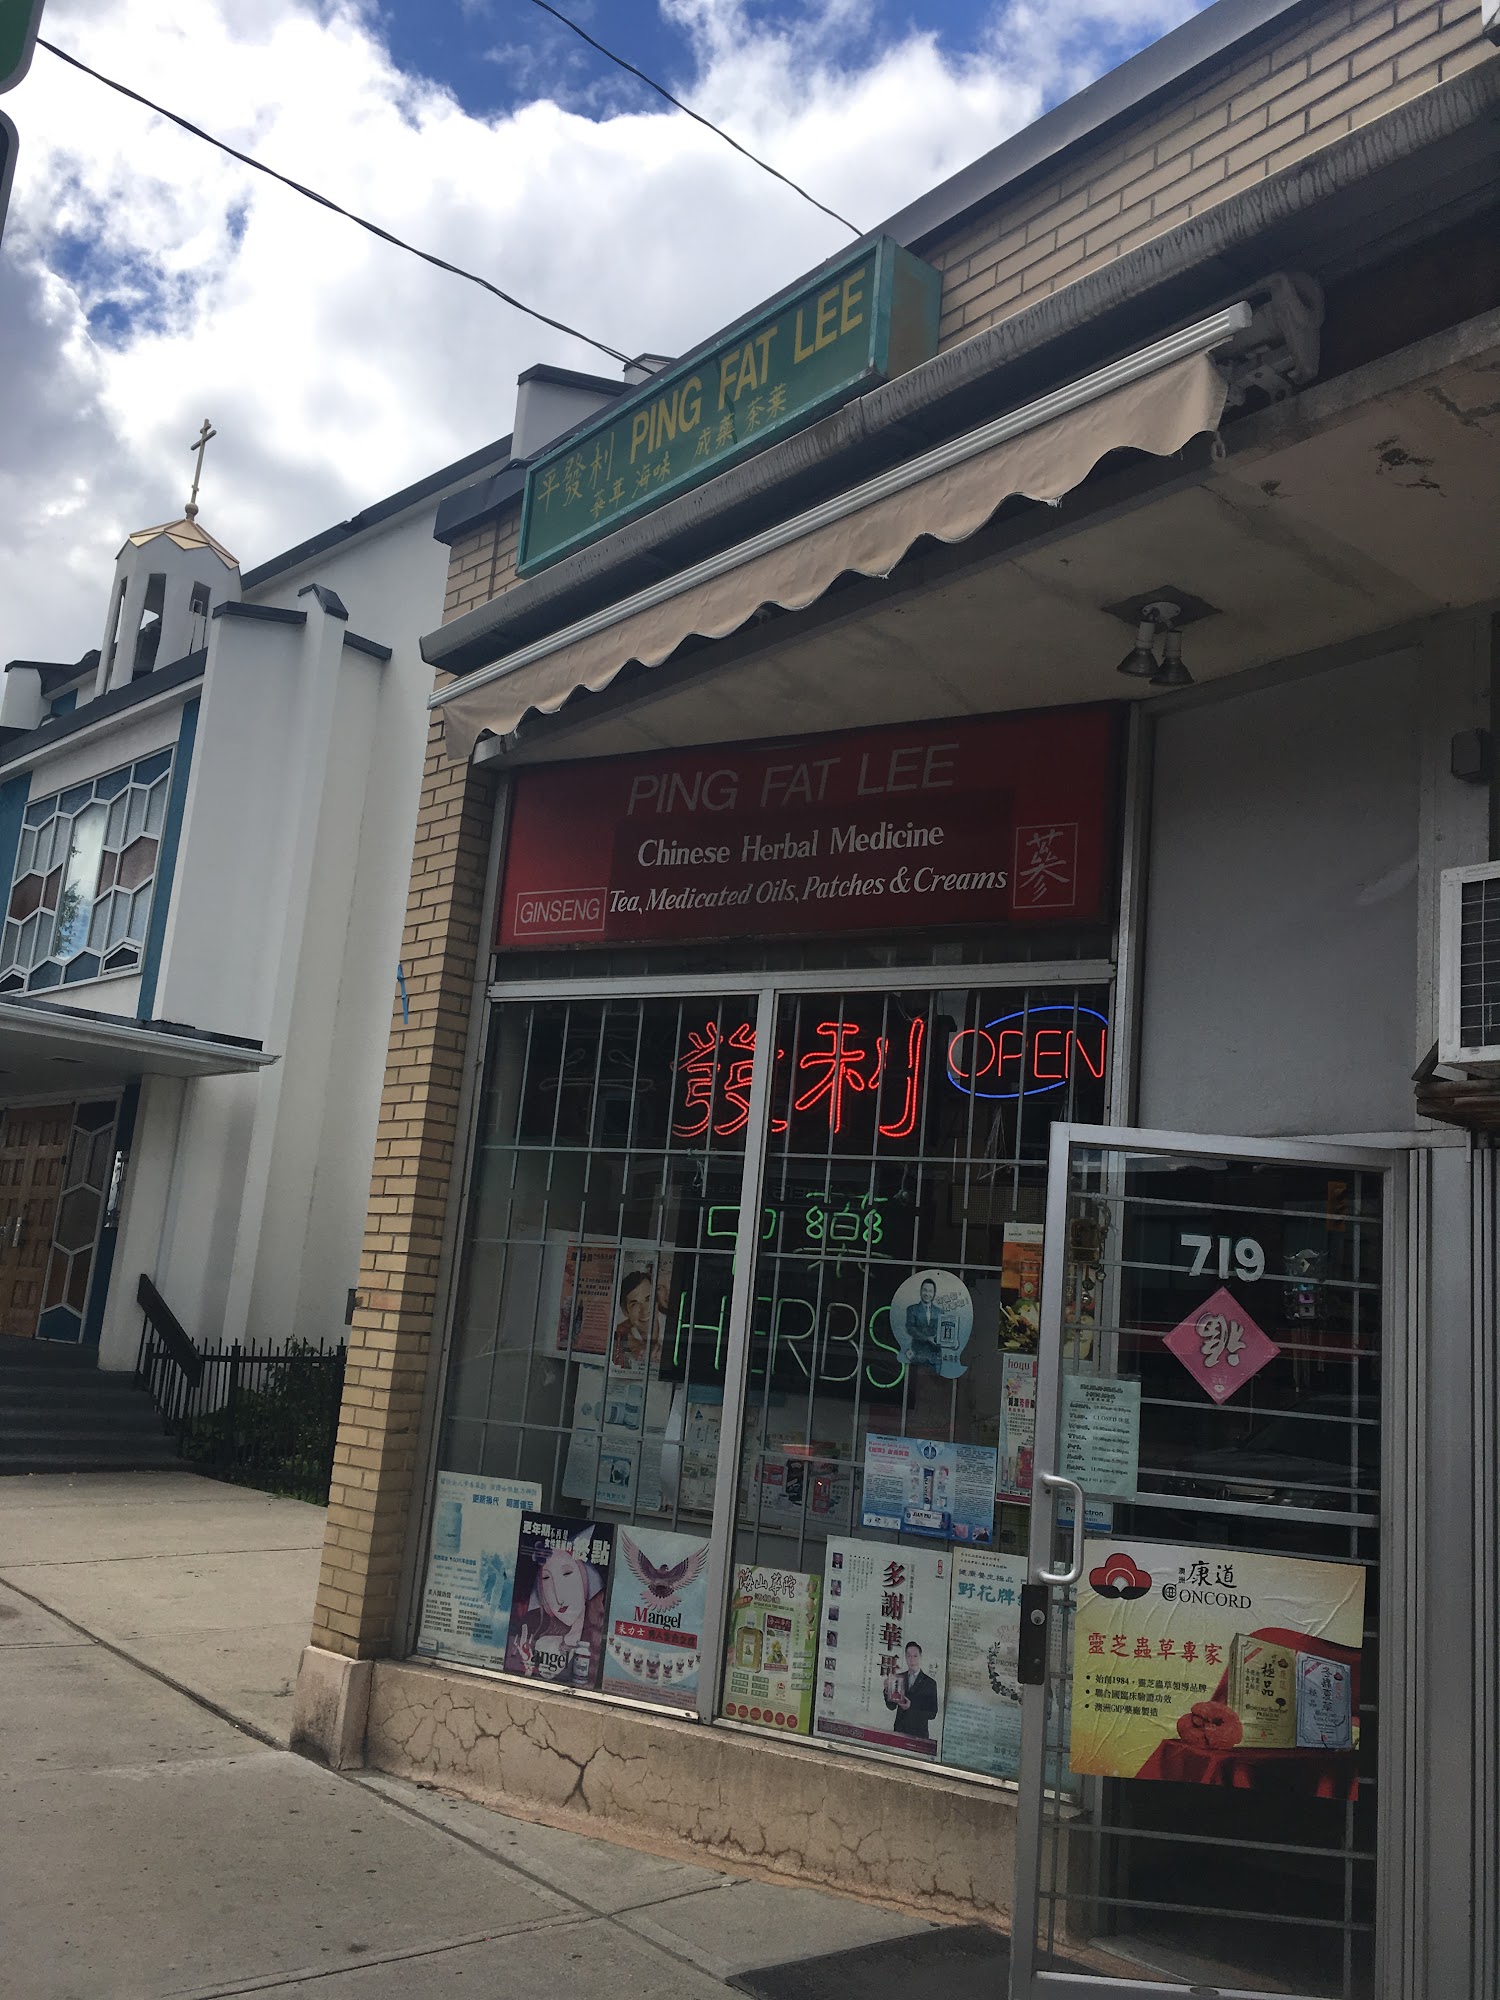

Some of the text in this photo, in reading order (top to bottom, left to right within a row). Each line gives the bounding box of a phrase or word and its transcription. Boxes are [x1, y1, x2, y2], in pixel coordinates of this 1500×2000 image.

[630, 267, 866, 466] PING FAT LEE
[537, 431, 615, 512] 平發利
[627, 743, 960, 817] PING FAT LEE
[636, 821, 945, 869] Chinese Herbal Medicine
[519, 897, 602, 924] GINSENG
[608, 888, 644, 914] Tea,
[645, 882, 754, 911] Medicated
[755, 880, 802, 906] Oils,
[802, 873, 886, 902] Patches
[948, 1028, 1106, 1081] OPEN
[1180, 1231, 1266, 1283] 719
[1066, 1507, 1104, 1517] Prctron
[1186, 1560, 1238, 1589] 康道
[1162, 1583, 1252, 1610] CONCORD
[633, 1606, 682, 1631] Mangel
[877, 1561, 906, 1677] 多謝華哥
[521, 1642, 569, 1673] Sangel
[1088, 1632, 1223, 1666] 靈芝蟲草專家
